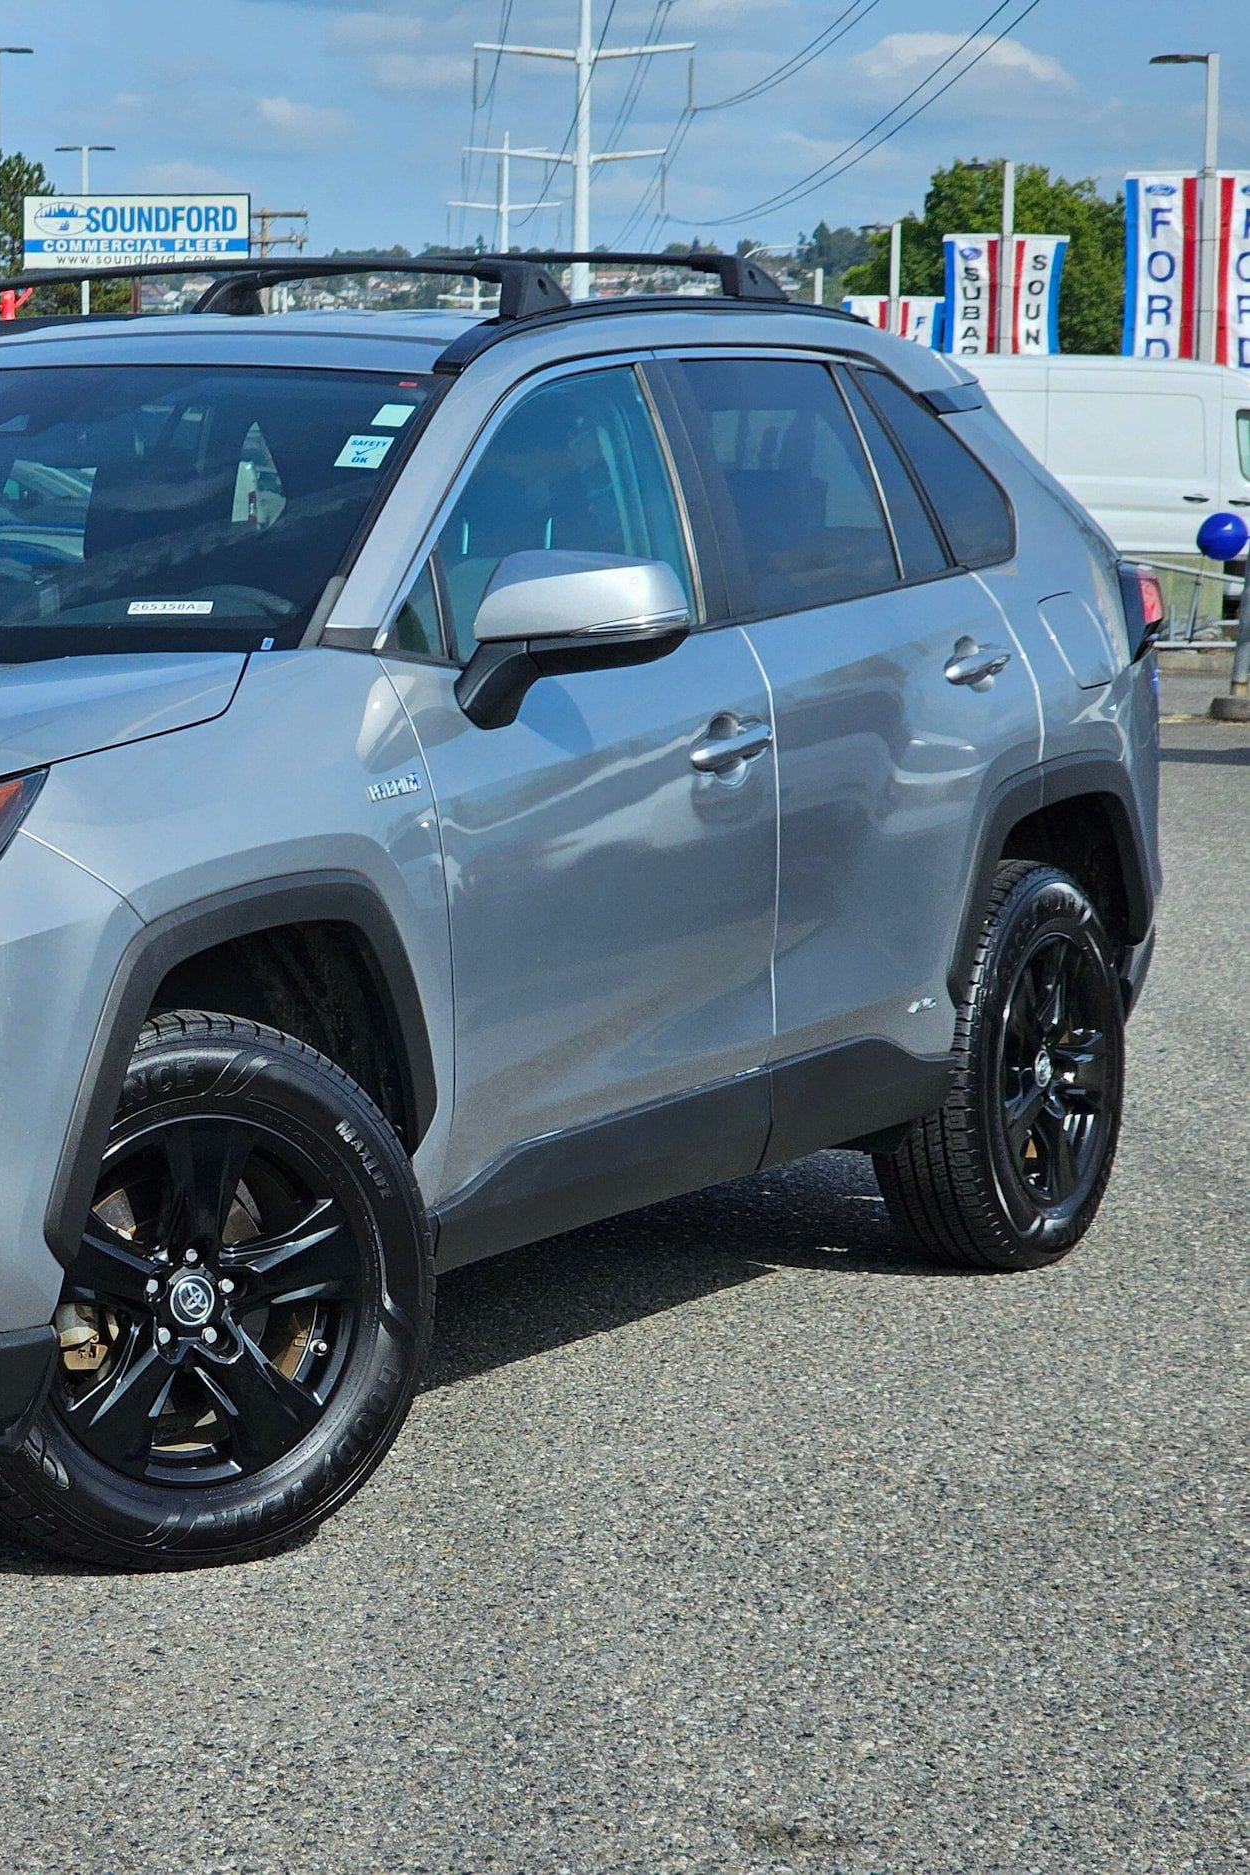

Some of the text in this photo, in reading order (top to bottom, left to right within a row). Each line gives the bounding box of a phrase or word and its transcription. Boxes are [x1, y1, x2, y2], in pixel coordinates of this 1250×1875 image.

[86, 206, 237, 232] SOUNDFORD
[43, 239, 230, 252] COMMERCIAL FLEET
[56, 252, 217, 265] www.soundfordcom
[1146, 207, 1176, 357] FORD
[351, 440, 389, 448] SAFETY
[351, 456, 369, 464] OK
[334, 1119, 395, 1201] MAXLIFE
